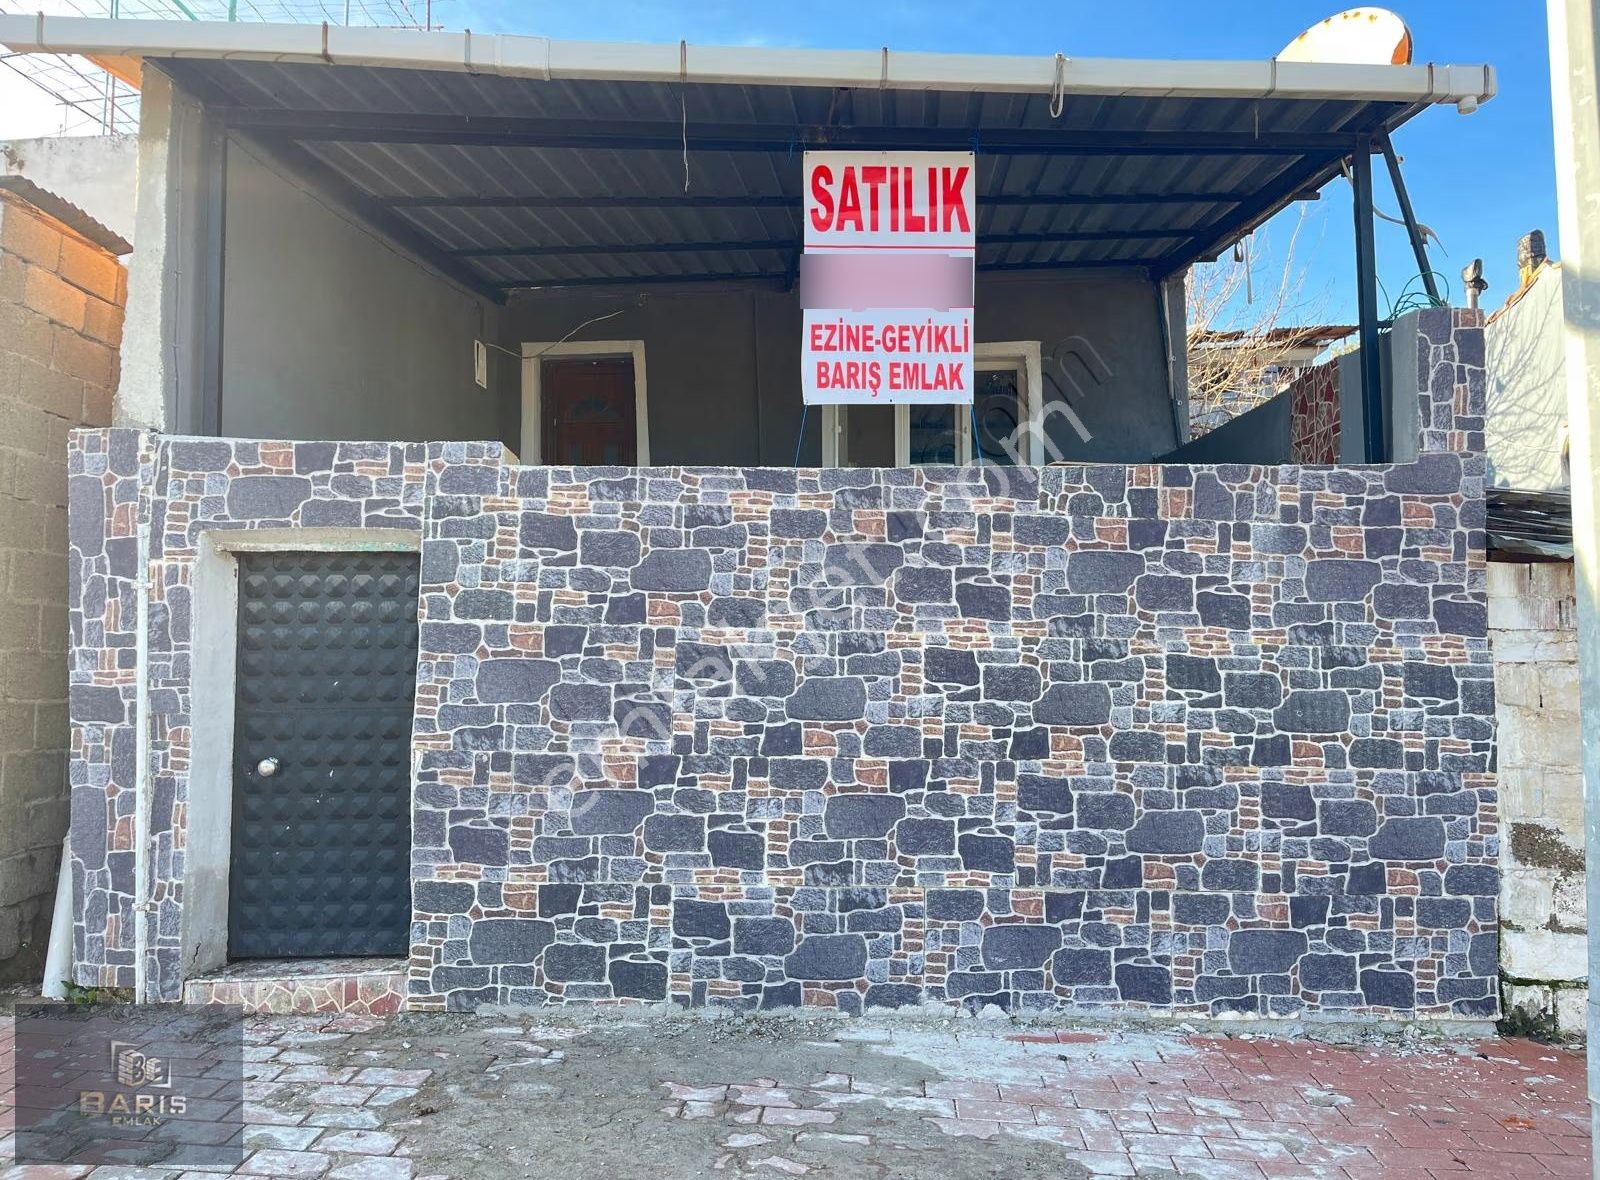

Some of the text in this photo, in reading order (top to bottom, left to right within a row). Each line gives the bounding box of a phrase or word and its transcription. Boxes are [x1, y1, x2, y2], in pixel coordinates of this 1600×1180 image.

[810, 165, 971, 233] SATILIK
[810, 318, 969, 353] EZİNE-GEYİKLİ
[816, 361, 964, 397] BARIŞ EMLAK
